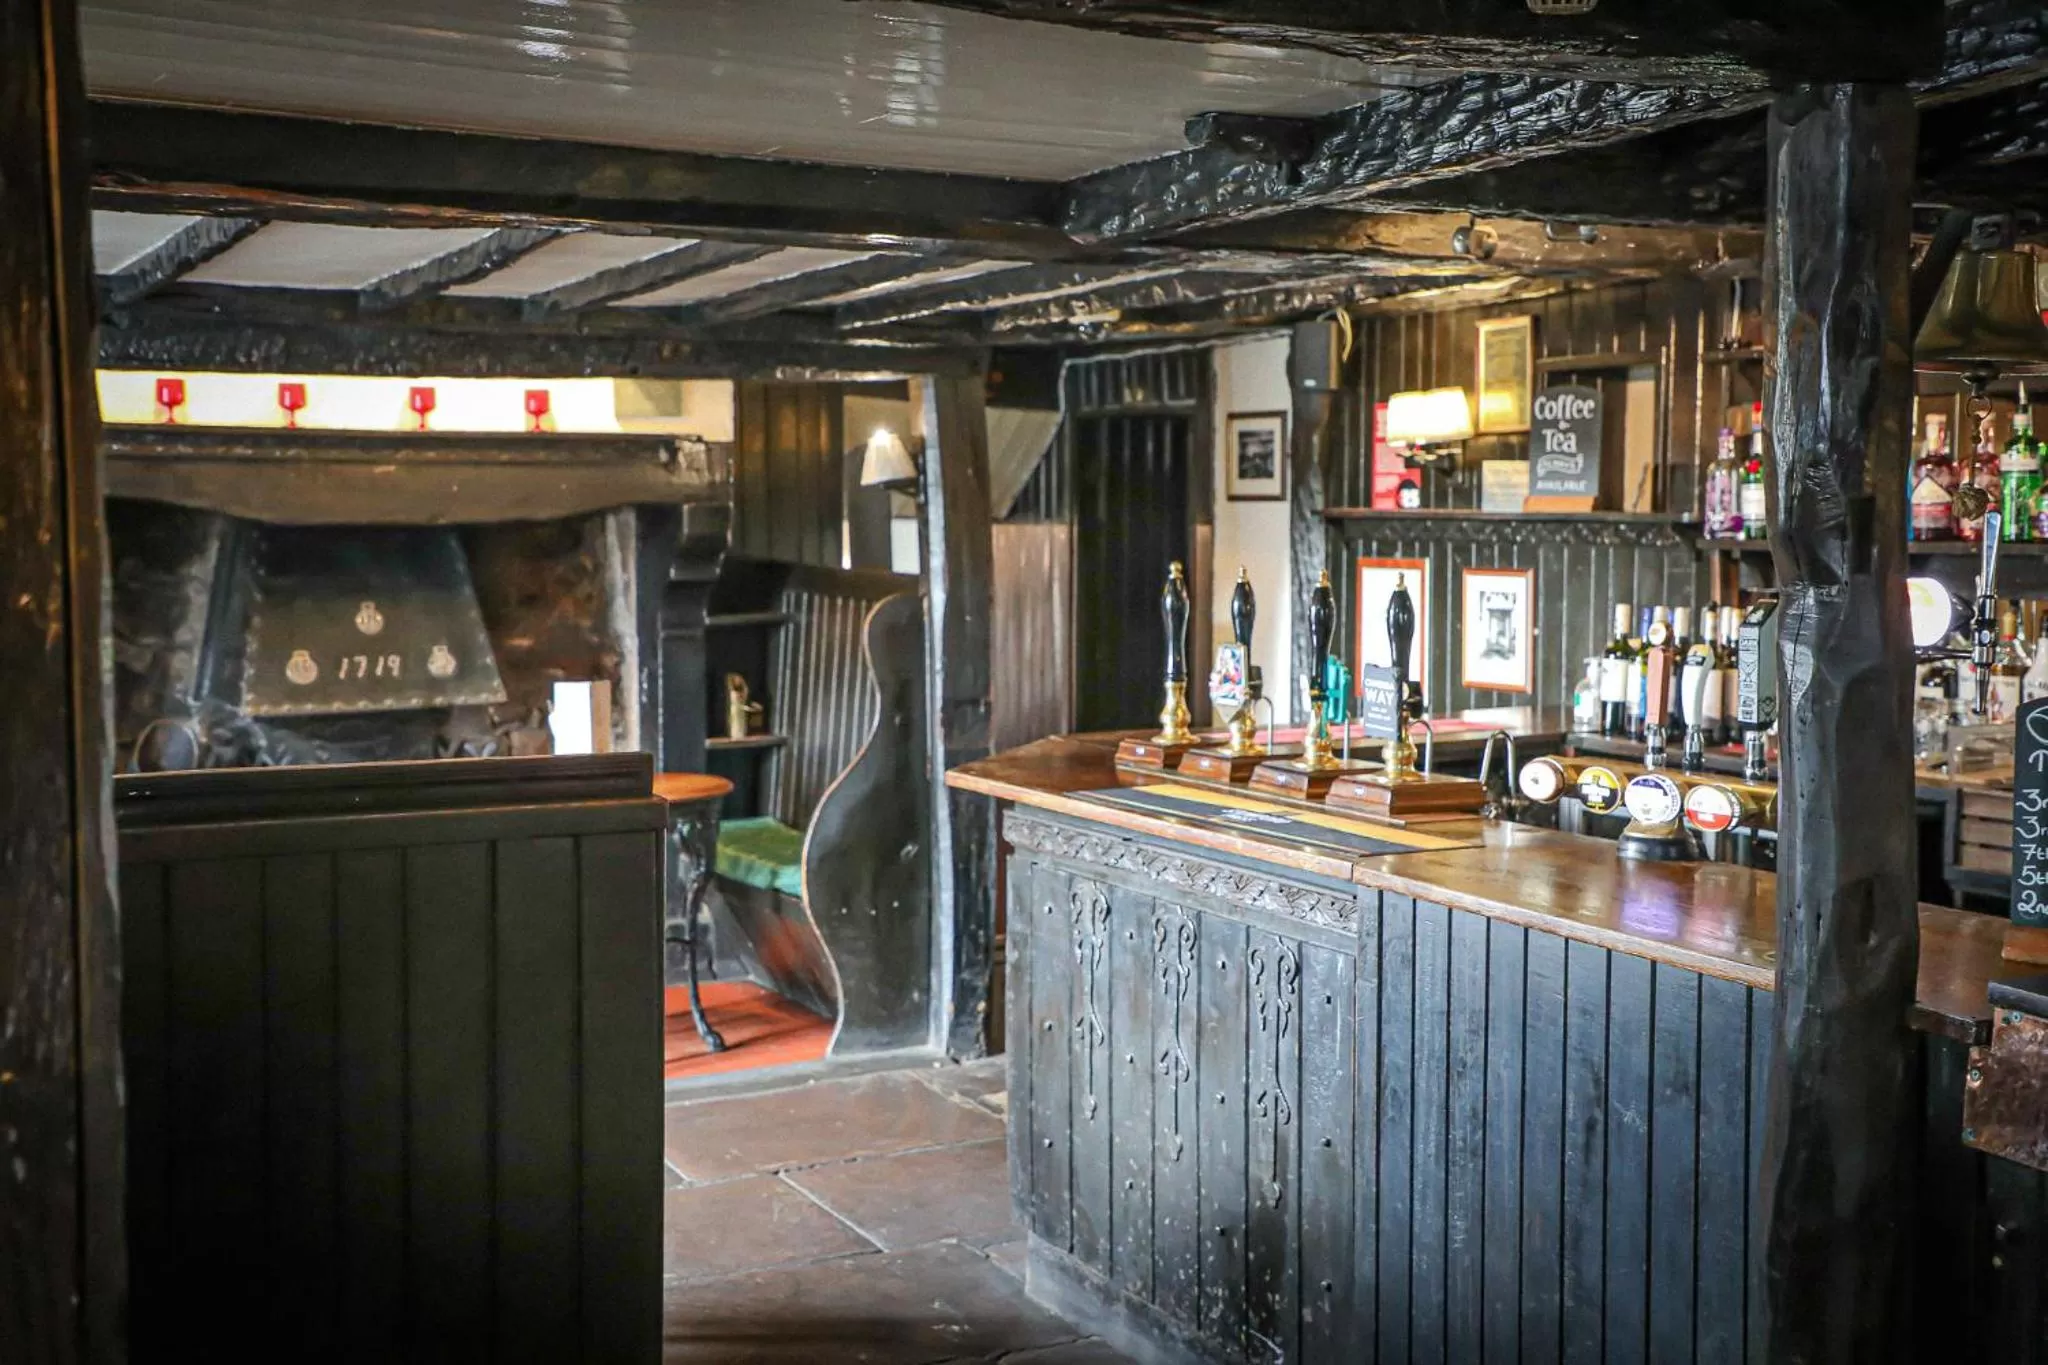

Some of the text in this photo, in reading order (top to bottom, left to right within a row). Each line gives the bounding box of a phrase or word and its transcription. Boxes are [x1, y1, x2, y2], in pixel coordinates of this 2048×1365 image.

[1534, 394, 1596, 420] Coffee
[1541, 428, 1577, 453] Tea
[339, 654, 401, 679] 1719
[1364, 687, 1395, 706] WAY
